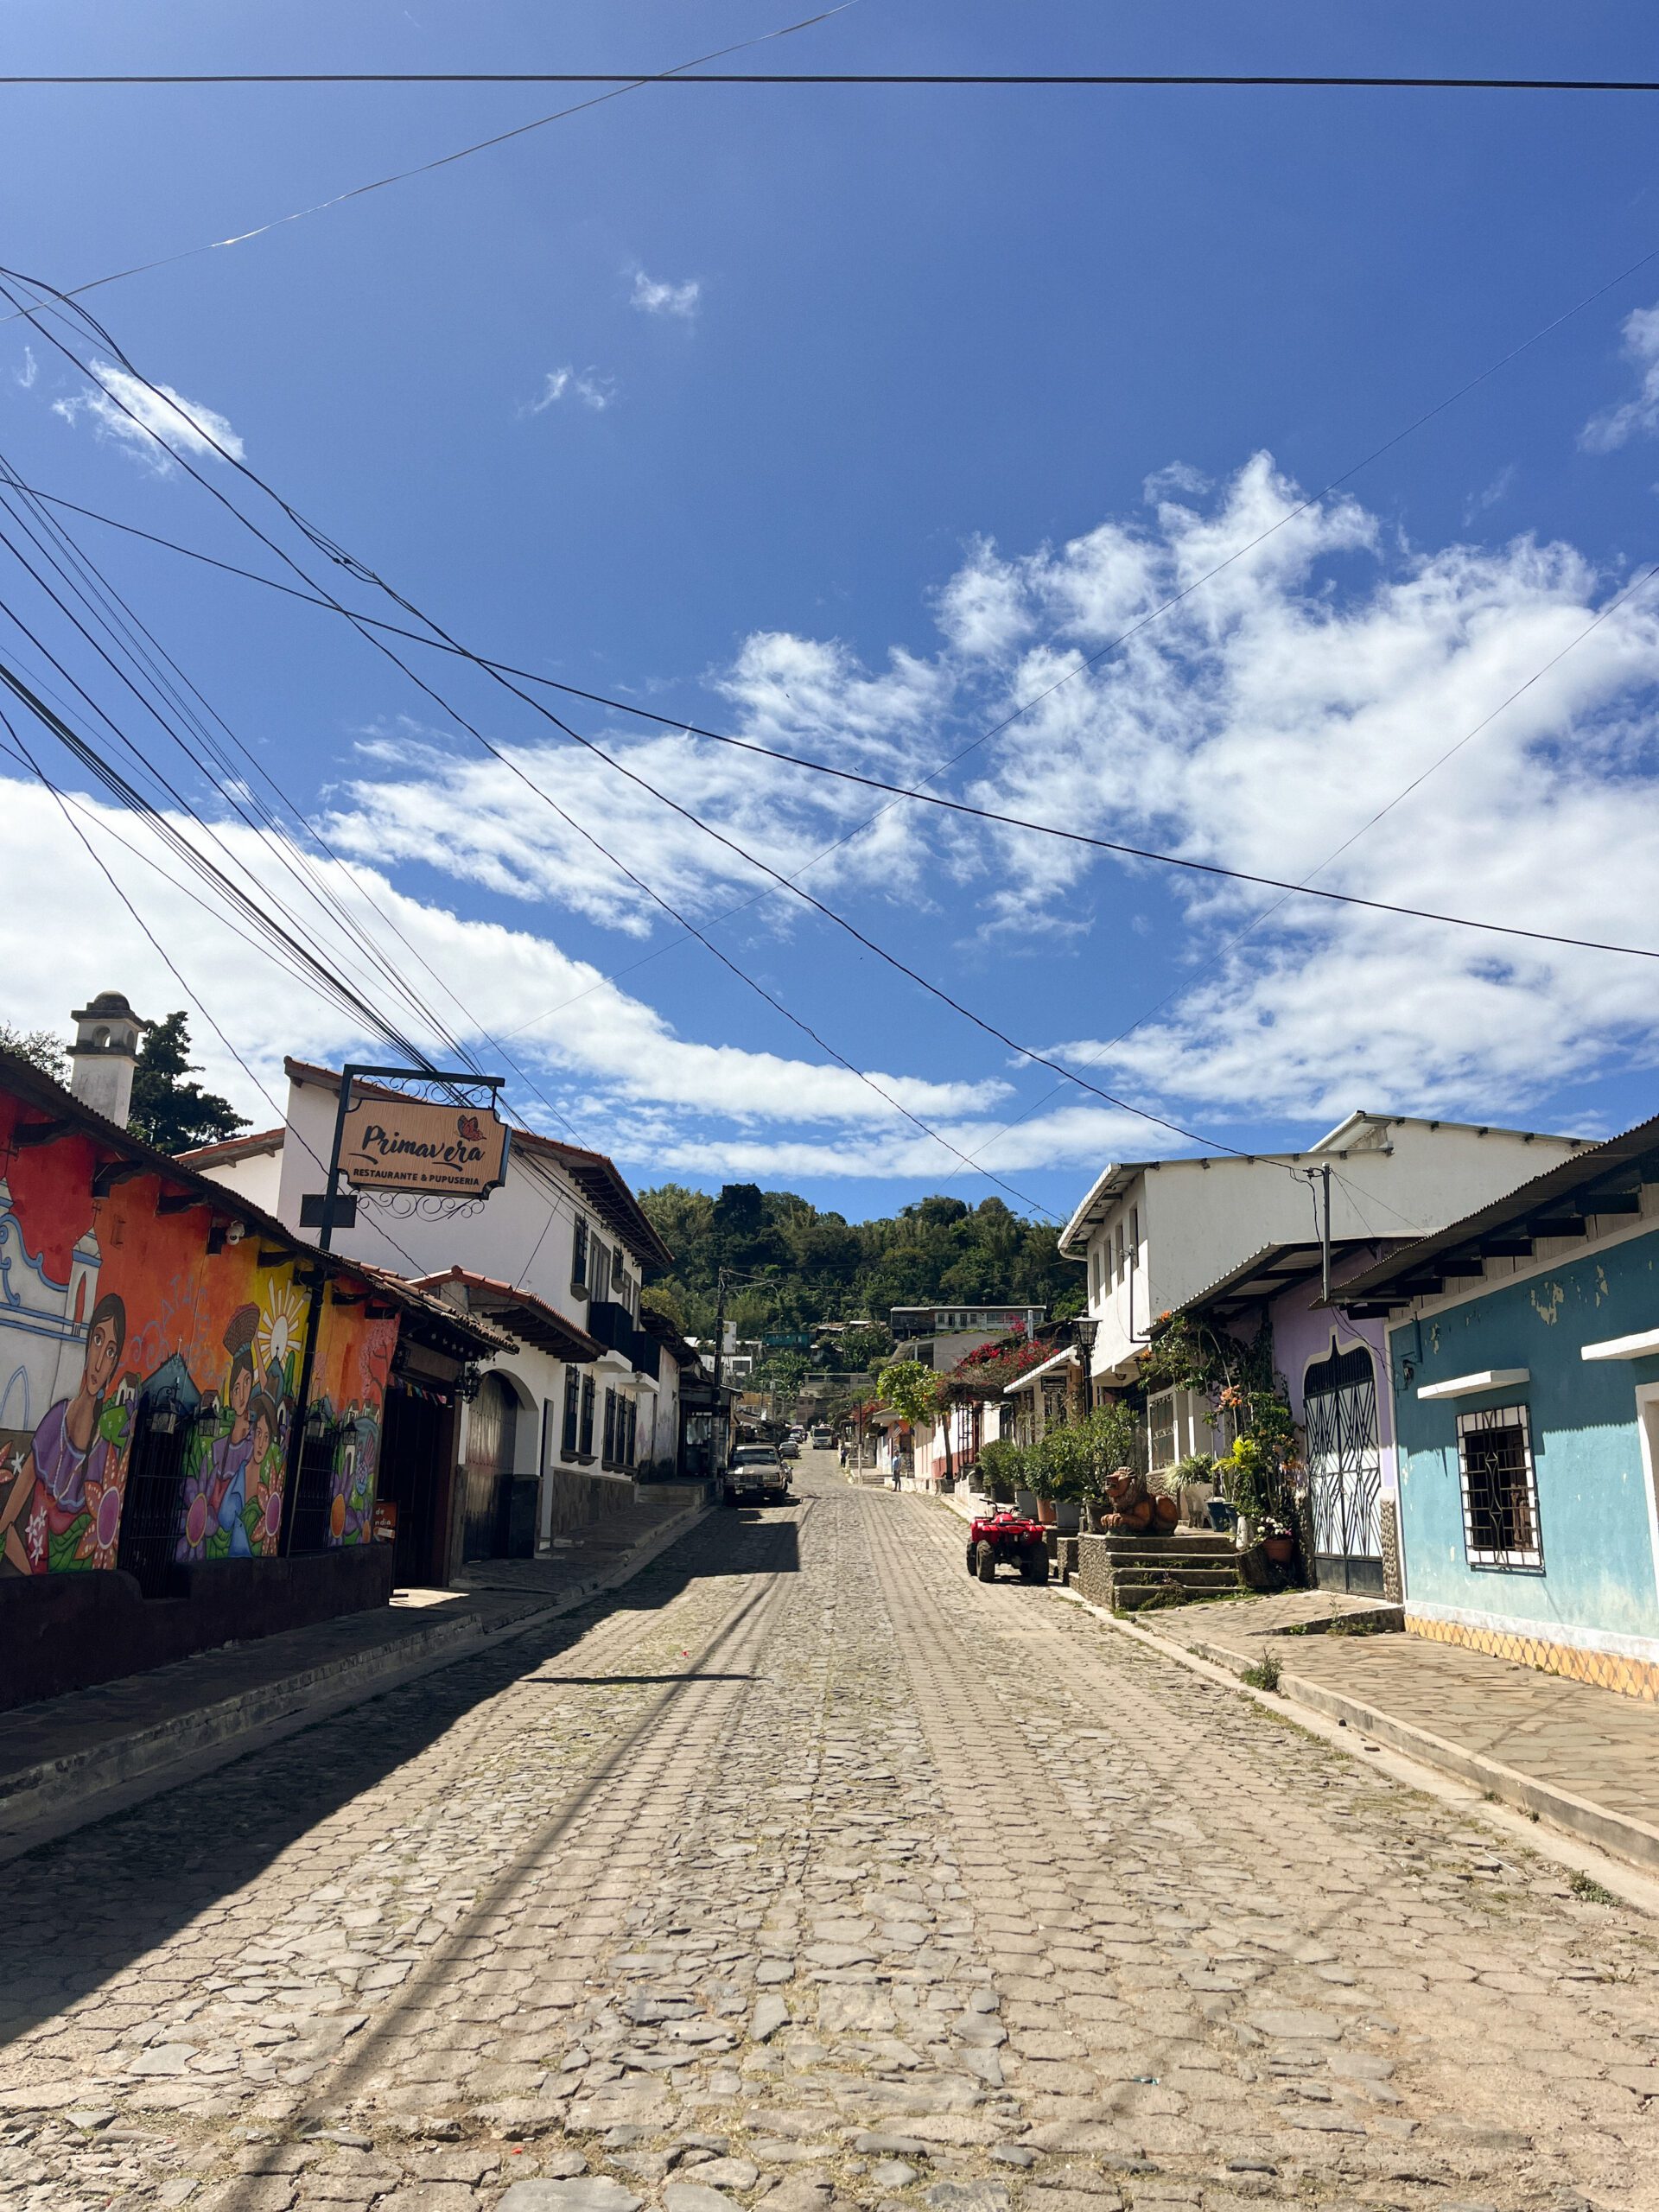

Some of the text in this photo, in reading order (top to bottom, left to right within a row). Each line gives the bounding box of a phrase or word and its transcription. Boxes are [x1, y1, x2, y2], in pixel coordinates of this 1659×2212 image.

[362, 1125, 486, 1163] Primavera
[353, 1168, 418, 1181] RESTAURANTE
[429, 1174, 480, 1185] PUPUSERIA
